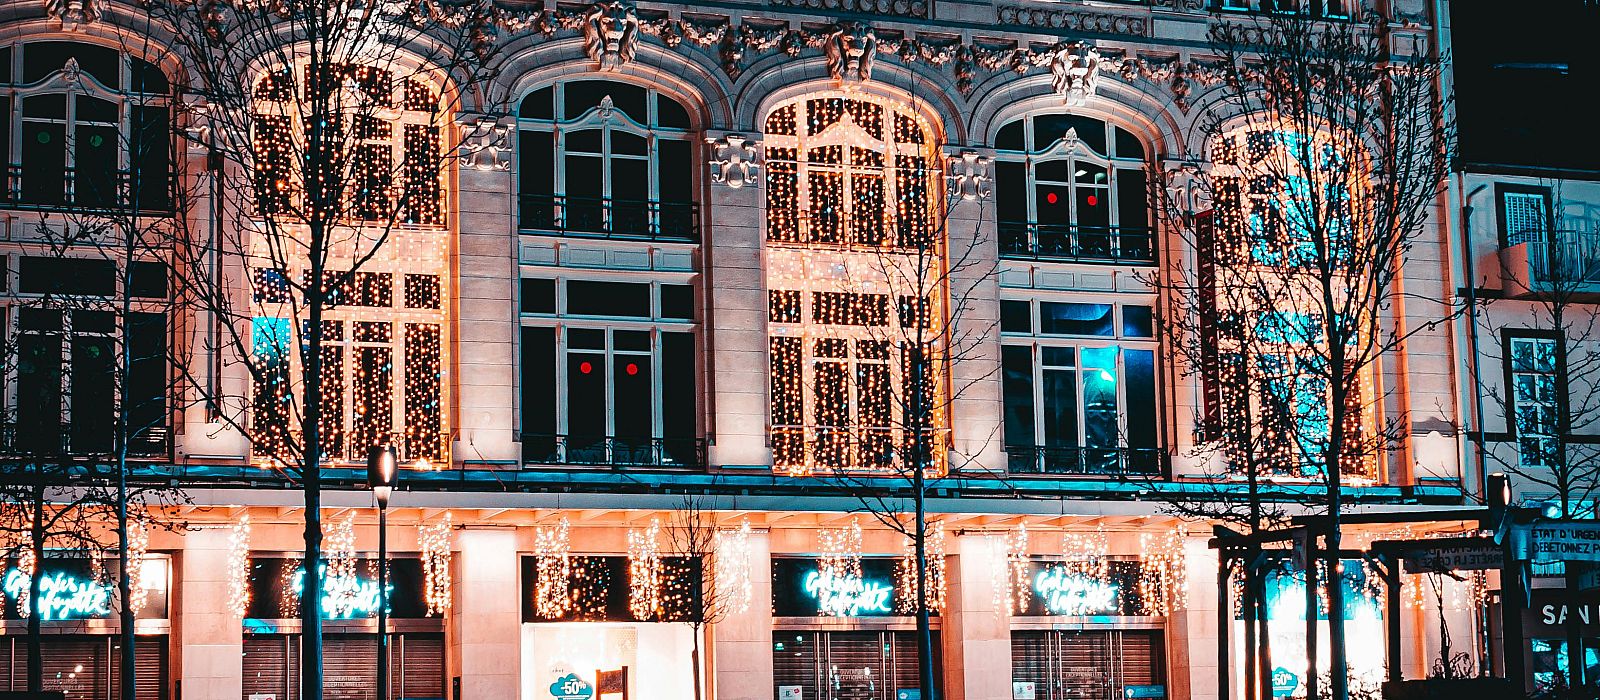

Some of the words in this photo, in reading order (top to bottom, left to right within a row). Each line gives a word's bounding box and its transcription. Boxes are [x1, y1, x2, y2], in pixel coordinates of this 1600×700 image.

[1531, 525, 1556, 538] ÉTAT
[1542, 604, 1590, 625] SAN
[560, 681, 587, 695] -50%
